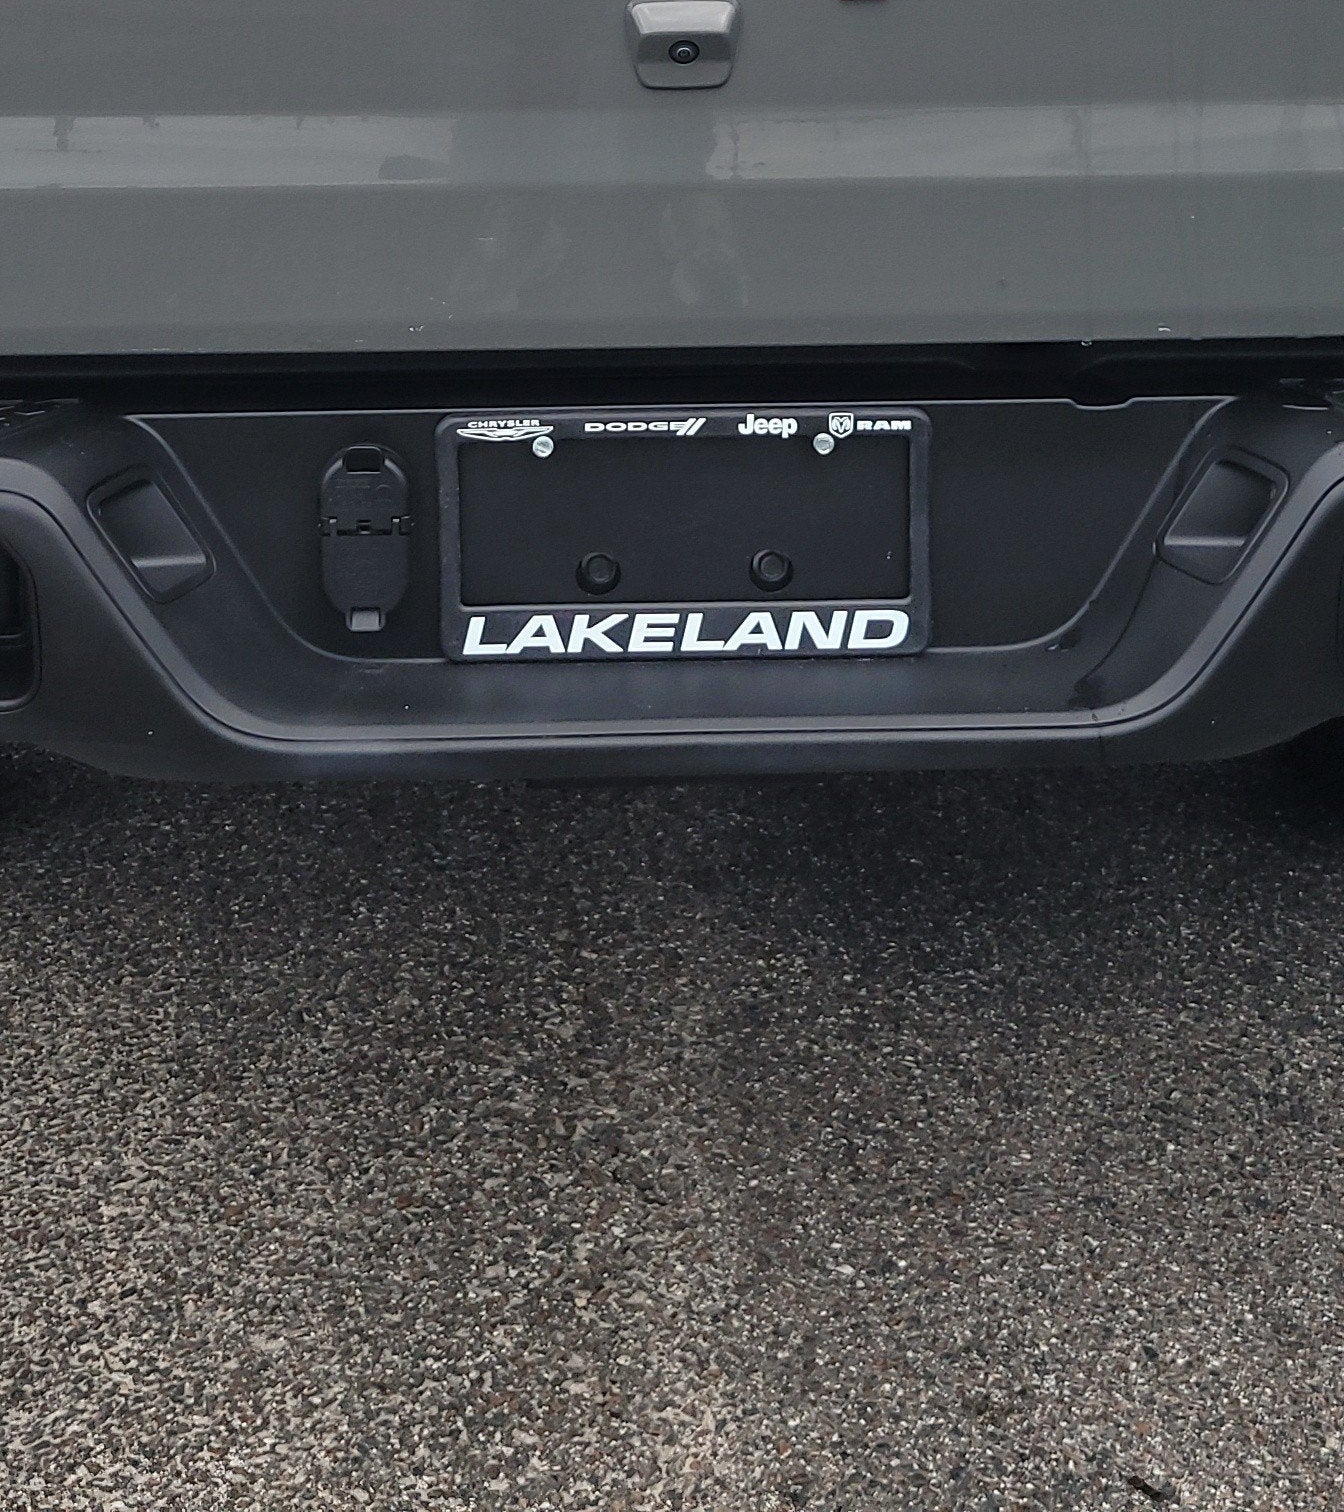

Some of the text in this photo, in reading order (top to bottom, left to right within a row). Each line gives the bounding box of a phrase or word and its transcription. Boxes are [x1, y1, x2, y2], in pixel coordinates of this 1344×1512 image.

[467, 419, 541, 429] CHRYSLER
[584, 420, 690, 432] DODGE
[738, 413, 798, 438] Jeep
[856, 419, 912, 431] RAM
[462, 609, 911, 655] LAKELAND
